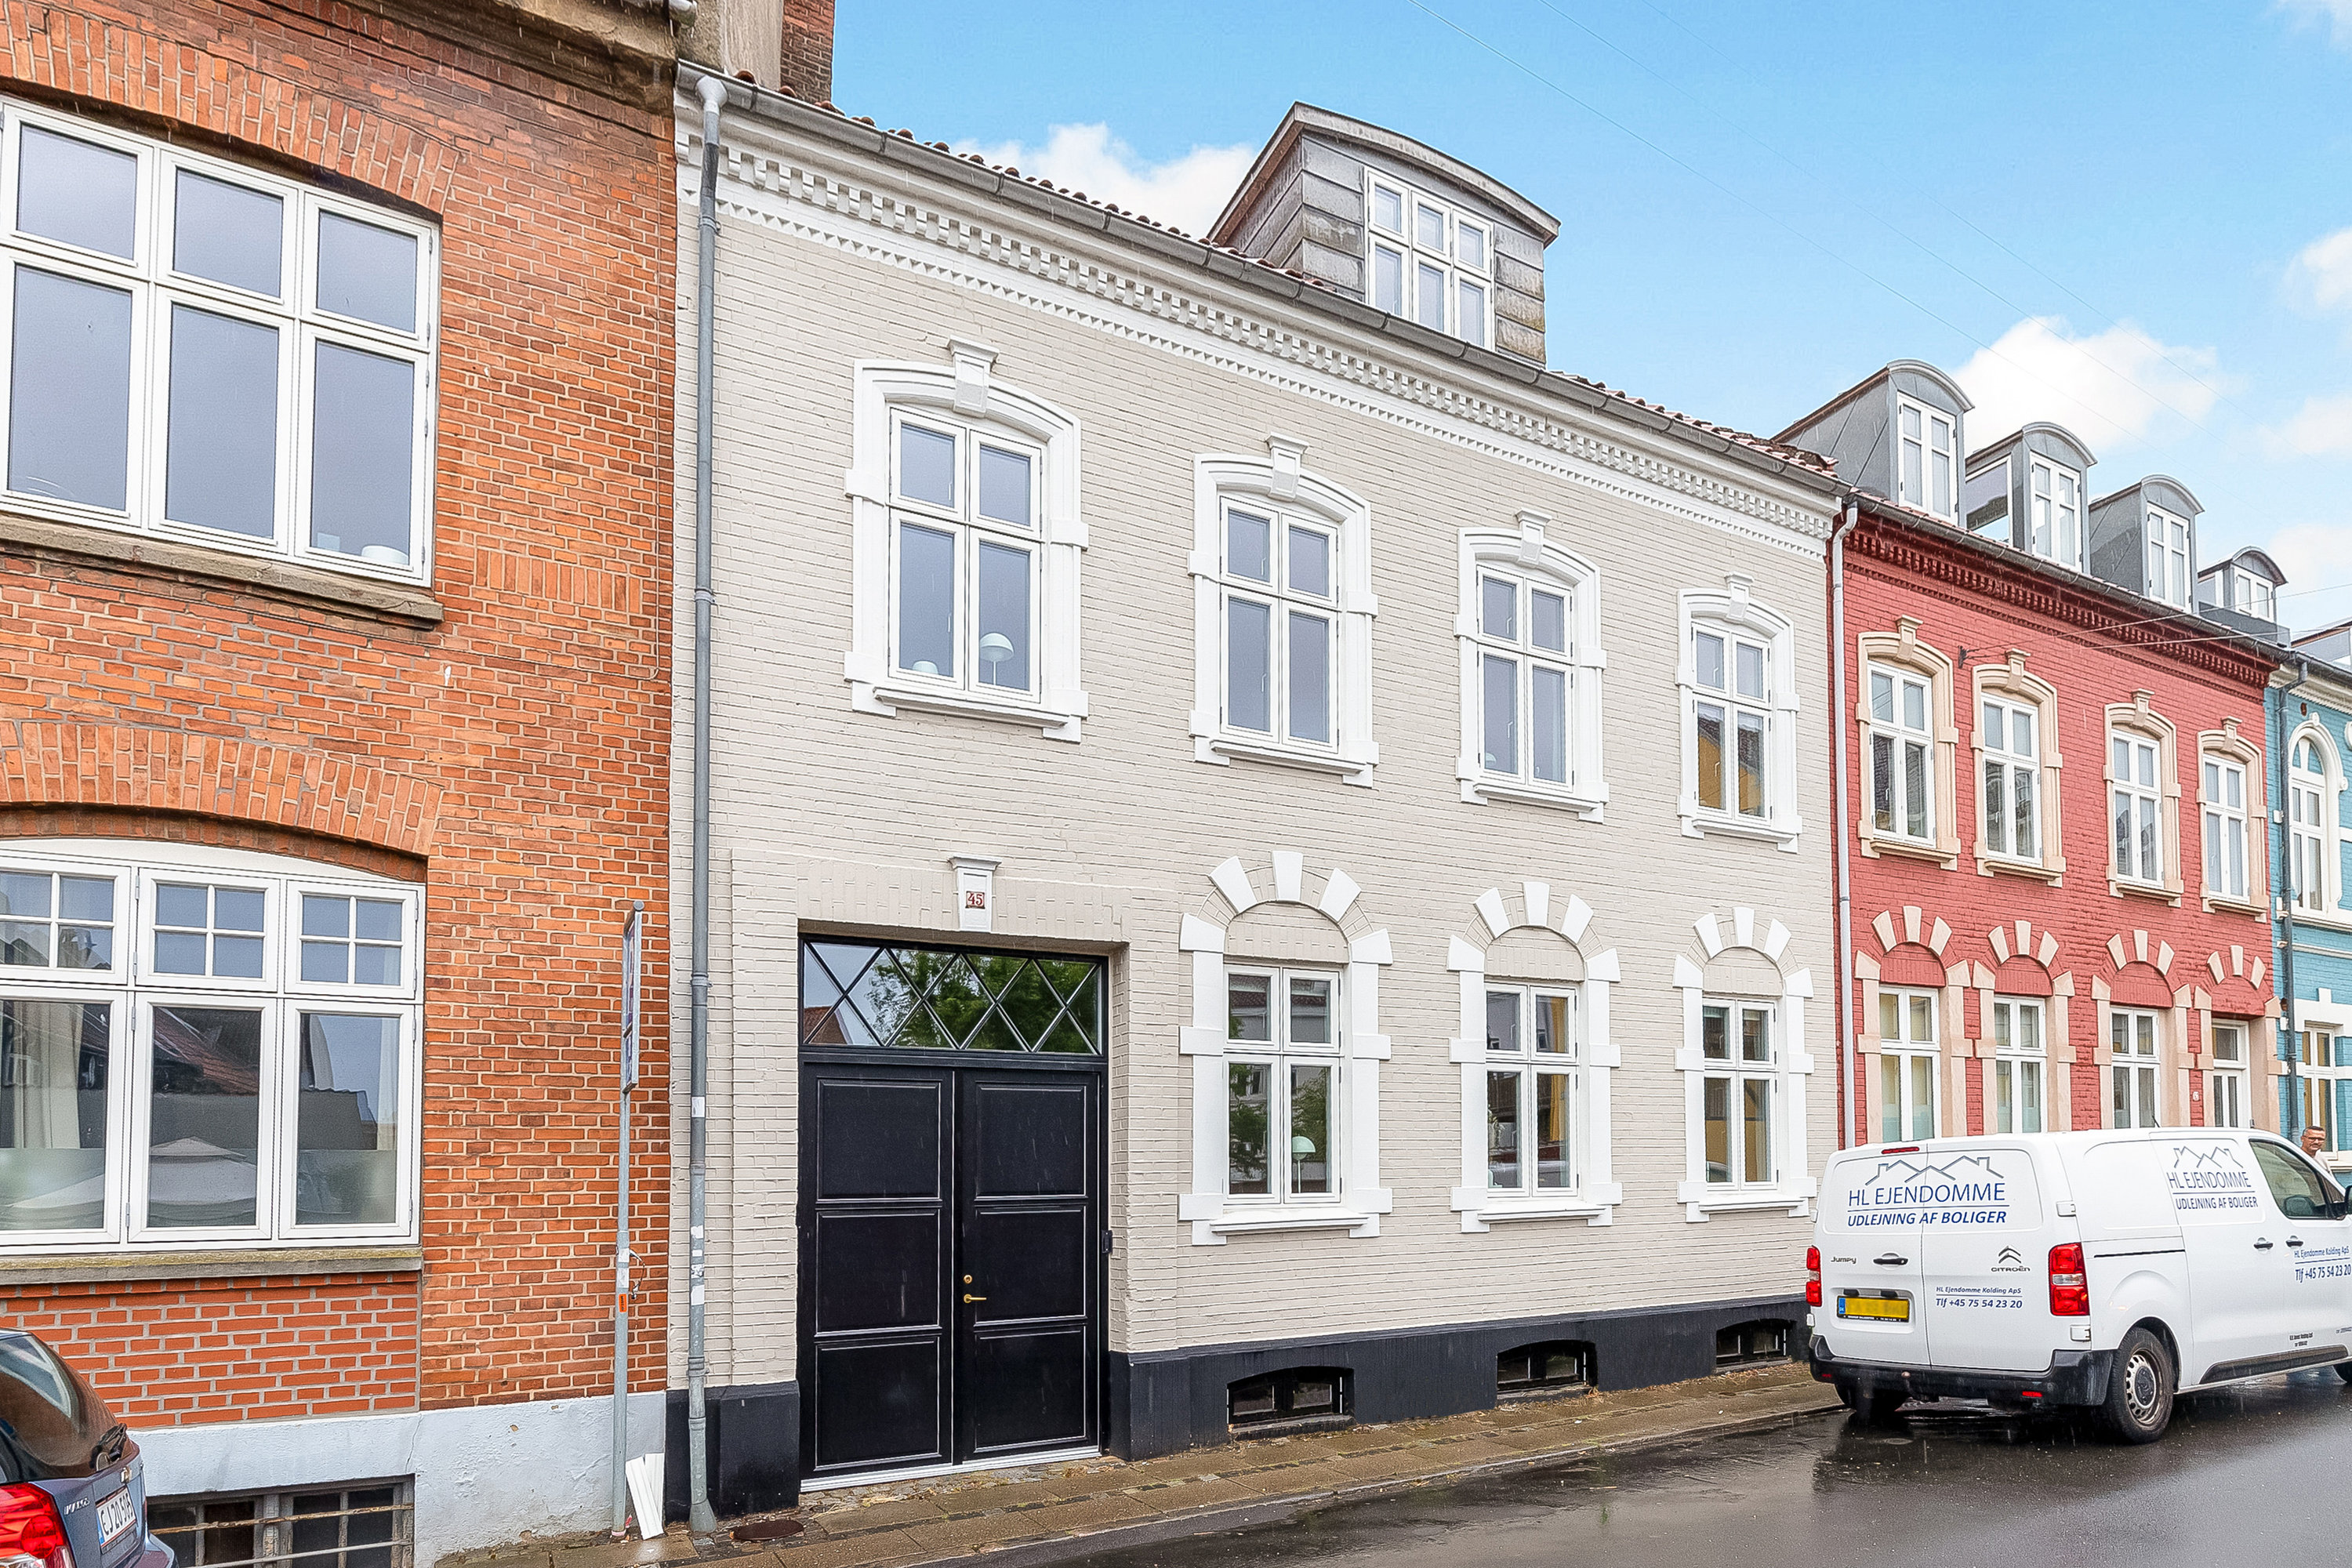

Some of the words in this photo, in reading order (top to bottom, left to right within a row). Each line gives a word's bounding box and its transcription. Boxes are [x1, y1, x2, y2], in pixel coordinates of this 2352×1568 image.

[967, 894, 983, 906] 45
[2166, 1172, 2185, 1189] HL
[2183, 1171, 2252, 1189] EJENDOMME
[1848, 1189, 1870, 1207] HL
[1875, 1182, 2006, 1205] EJENDOMME
[2175, 1197, 2217, 1210] UDLEJNING
[2218, 1197, 2227, 1208] AF
[2227, 1196, 2259, 1208] BOLIGER
[1847, 1212, 1917, 1227] UDLEJNING
[1918, 1212, 1938, 1225] AF
[1940, 1210, 2008, 1225] BOLIGER
[1831, 1256, 1857, 1265] Jumpy
[2295, 1268, 2304, 1283] Tlf
[2304, 1267, 2317, 1279] +45
[2318, 1266, 2325, 1278] 75
[2326, 1265, 2334, 1277] 54
[2335, 1265, 2343, 1276] 23
[2343, 1264, 2352, 1276] 20
[1936, 1298, 1947, 1308] Tlf
[1949, 1298, 1965, 1307] +45
[1968, 1299, 1980, 1308] 75
[1981, 1299, 1994, 1308] 54
[1995, 1299, 2008, 1308] 23
[2009, 1300, 2023, 1308] 20
[111, 1501, 123, 1530] 20
